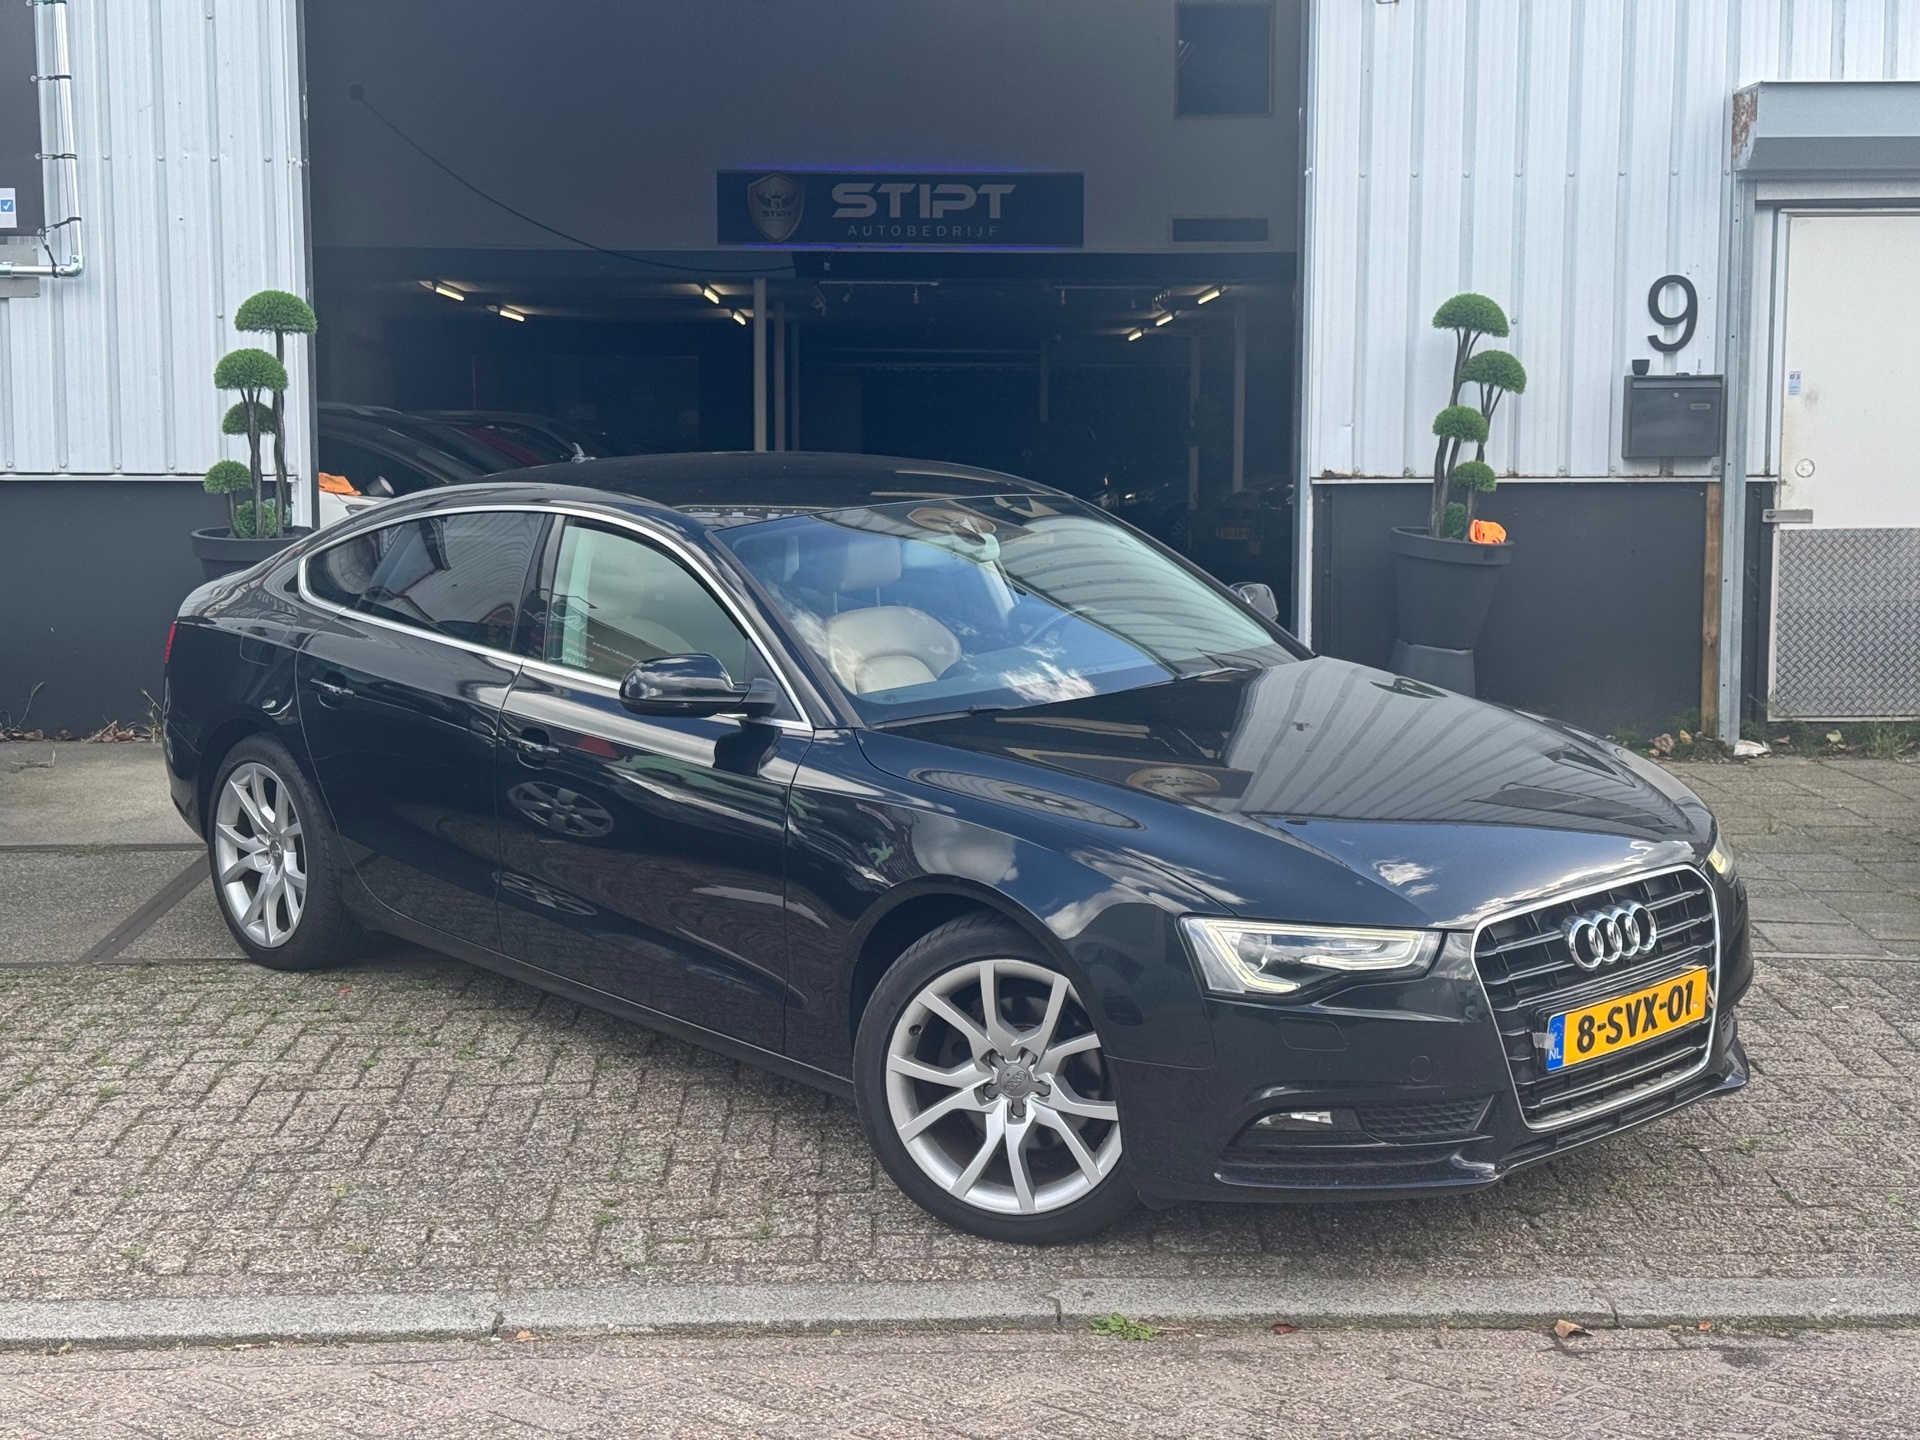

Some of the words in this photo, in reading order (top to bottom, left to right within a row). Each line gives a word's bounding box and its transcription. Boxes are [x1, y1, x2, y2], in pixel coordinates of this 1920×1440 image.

[831, 183, 1017, 219] STIPT
[847, 225, 998, 237] AUTOBEDRIJF
[1647, 274, 1698, 352] 9
[1577, 979, 1694, 1054] 8-SVX-01
[1548, 1047, 1562, 1061] NL
